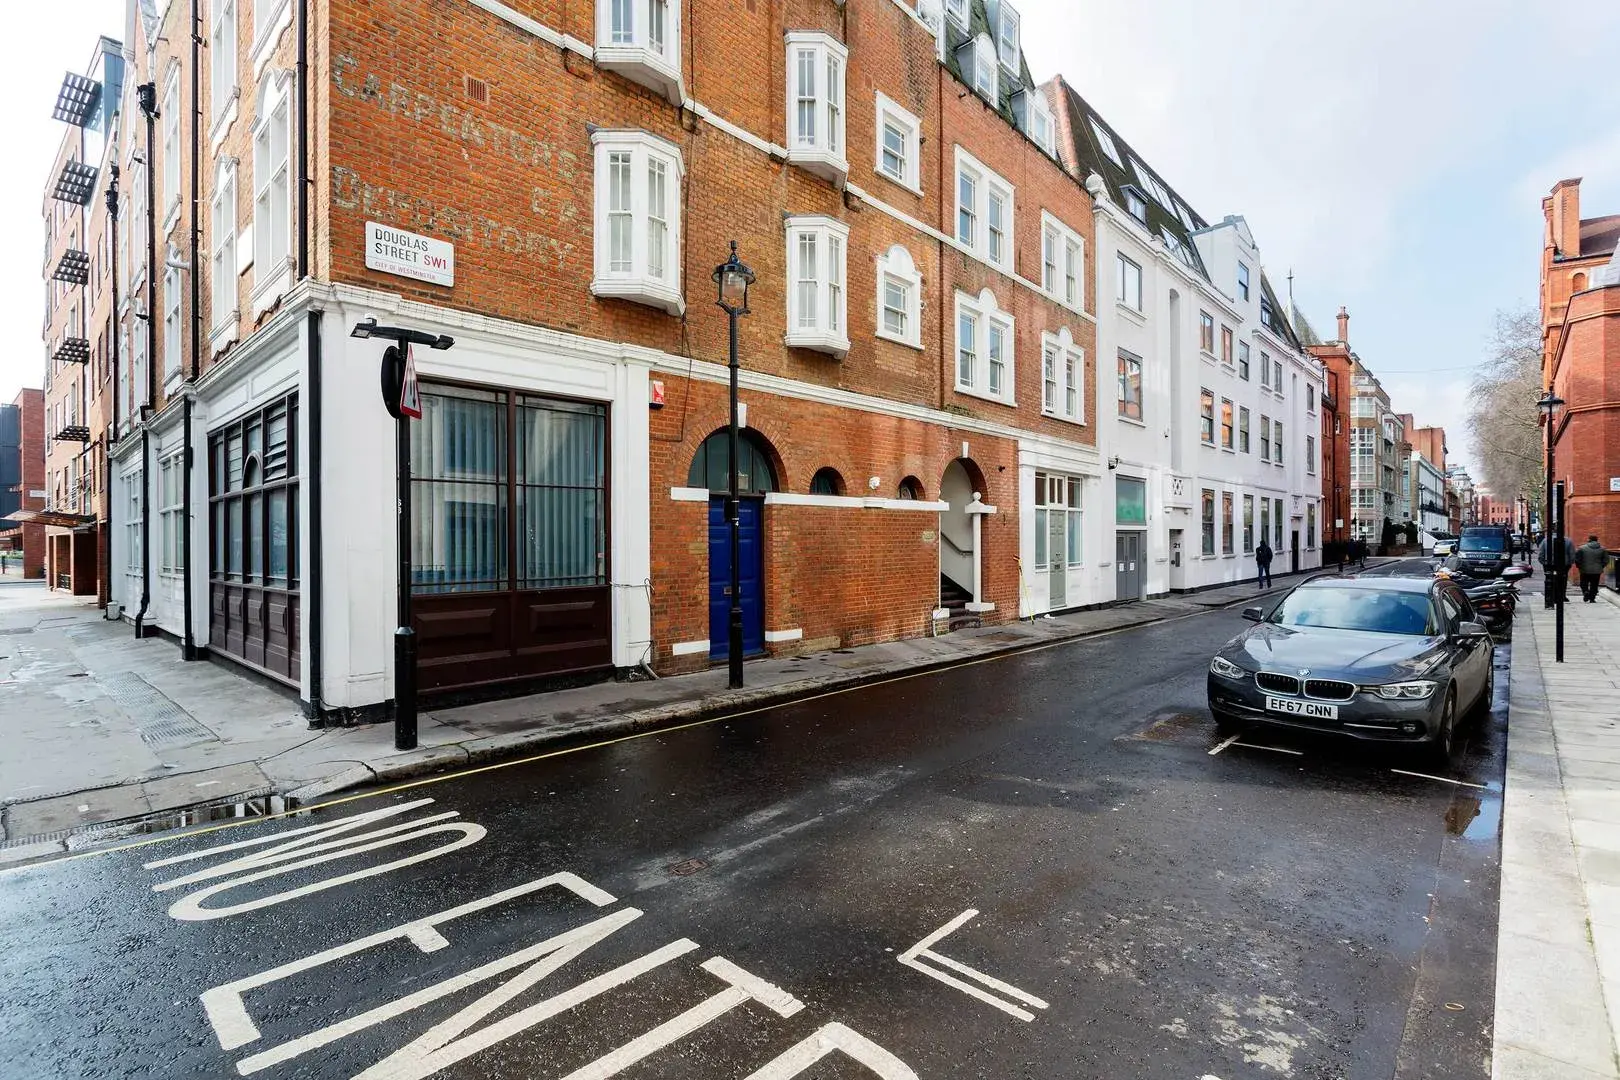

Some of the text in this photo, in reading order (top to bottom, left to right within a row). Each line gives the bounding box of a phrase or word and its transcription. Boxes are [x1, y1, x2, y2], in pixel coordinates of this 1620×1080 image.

[375, 228, 428, 252] DOUGLAS
[375, 242, 447, 270] STREET SW1
[398, 266, 436, 280] WESTMINSTER
[1271, 699, 1332, 717] EF67 GNN
[143, 797, 488, 921] NO
